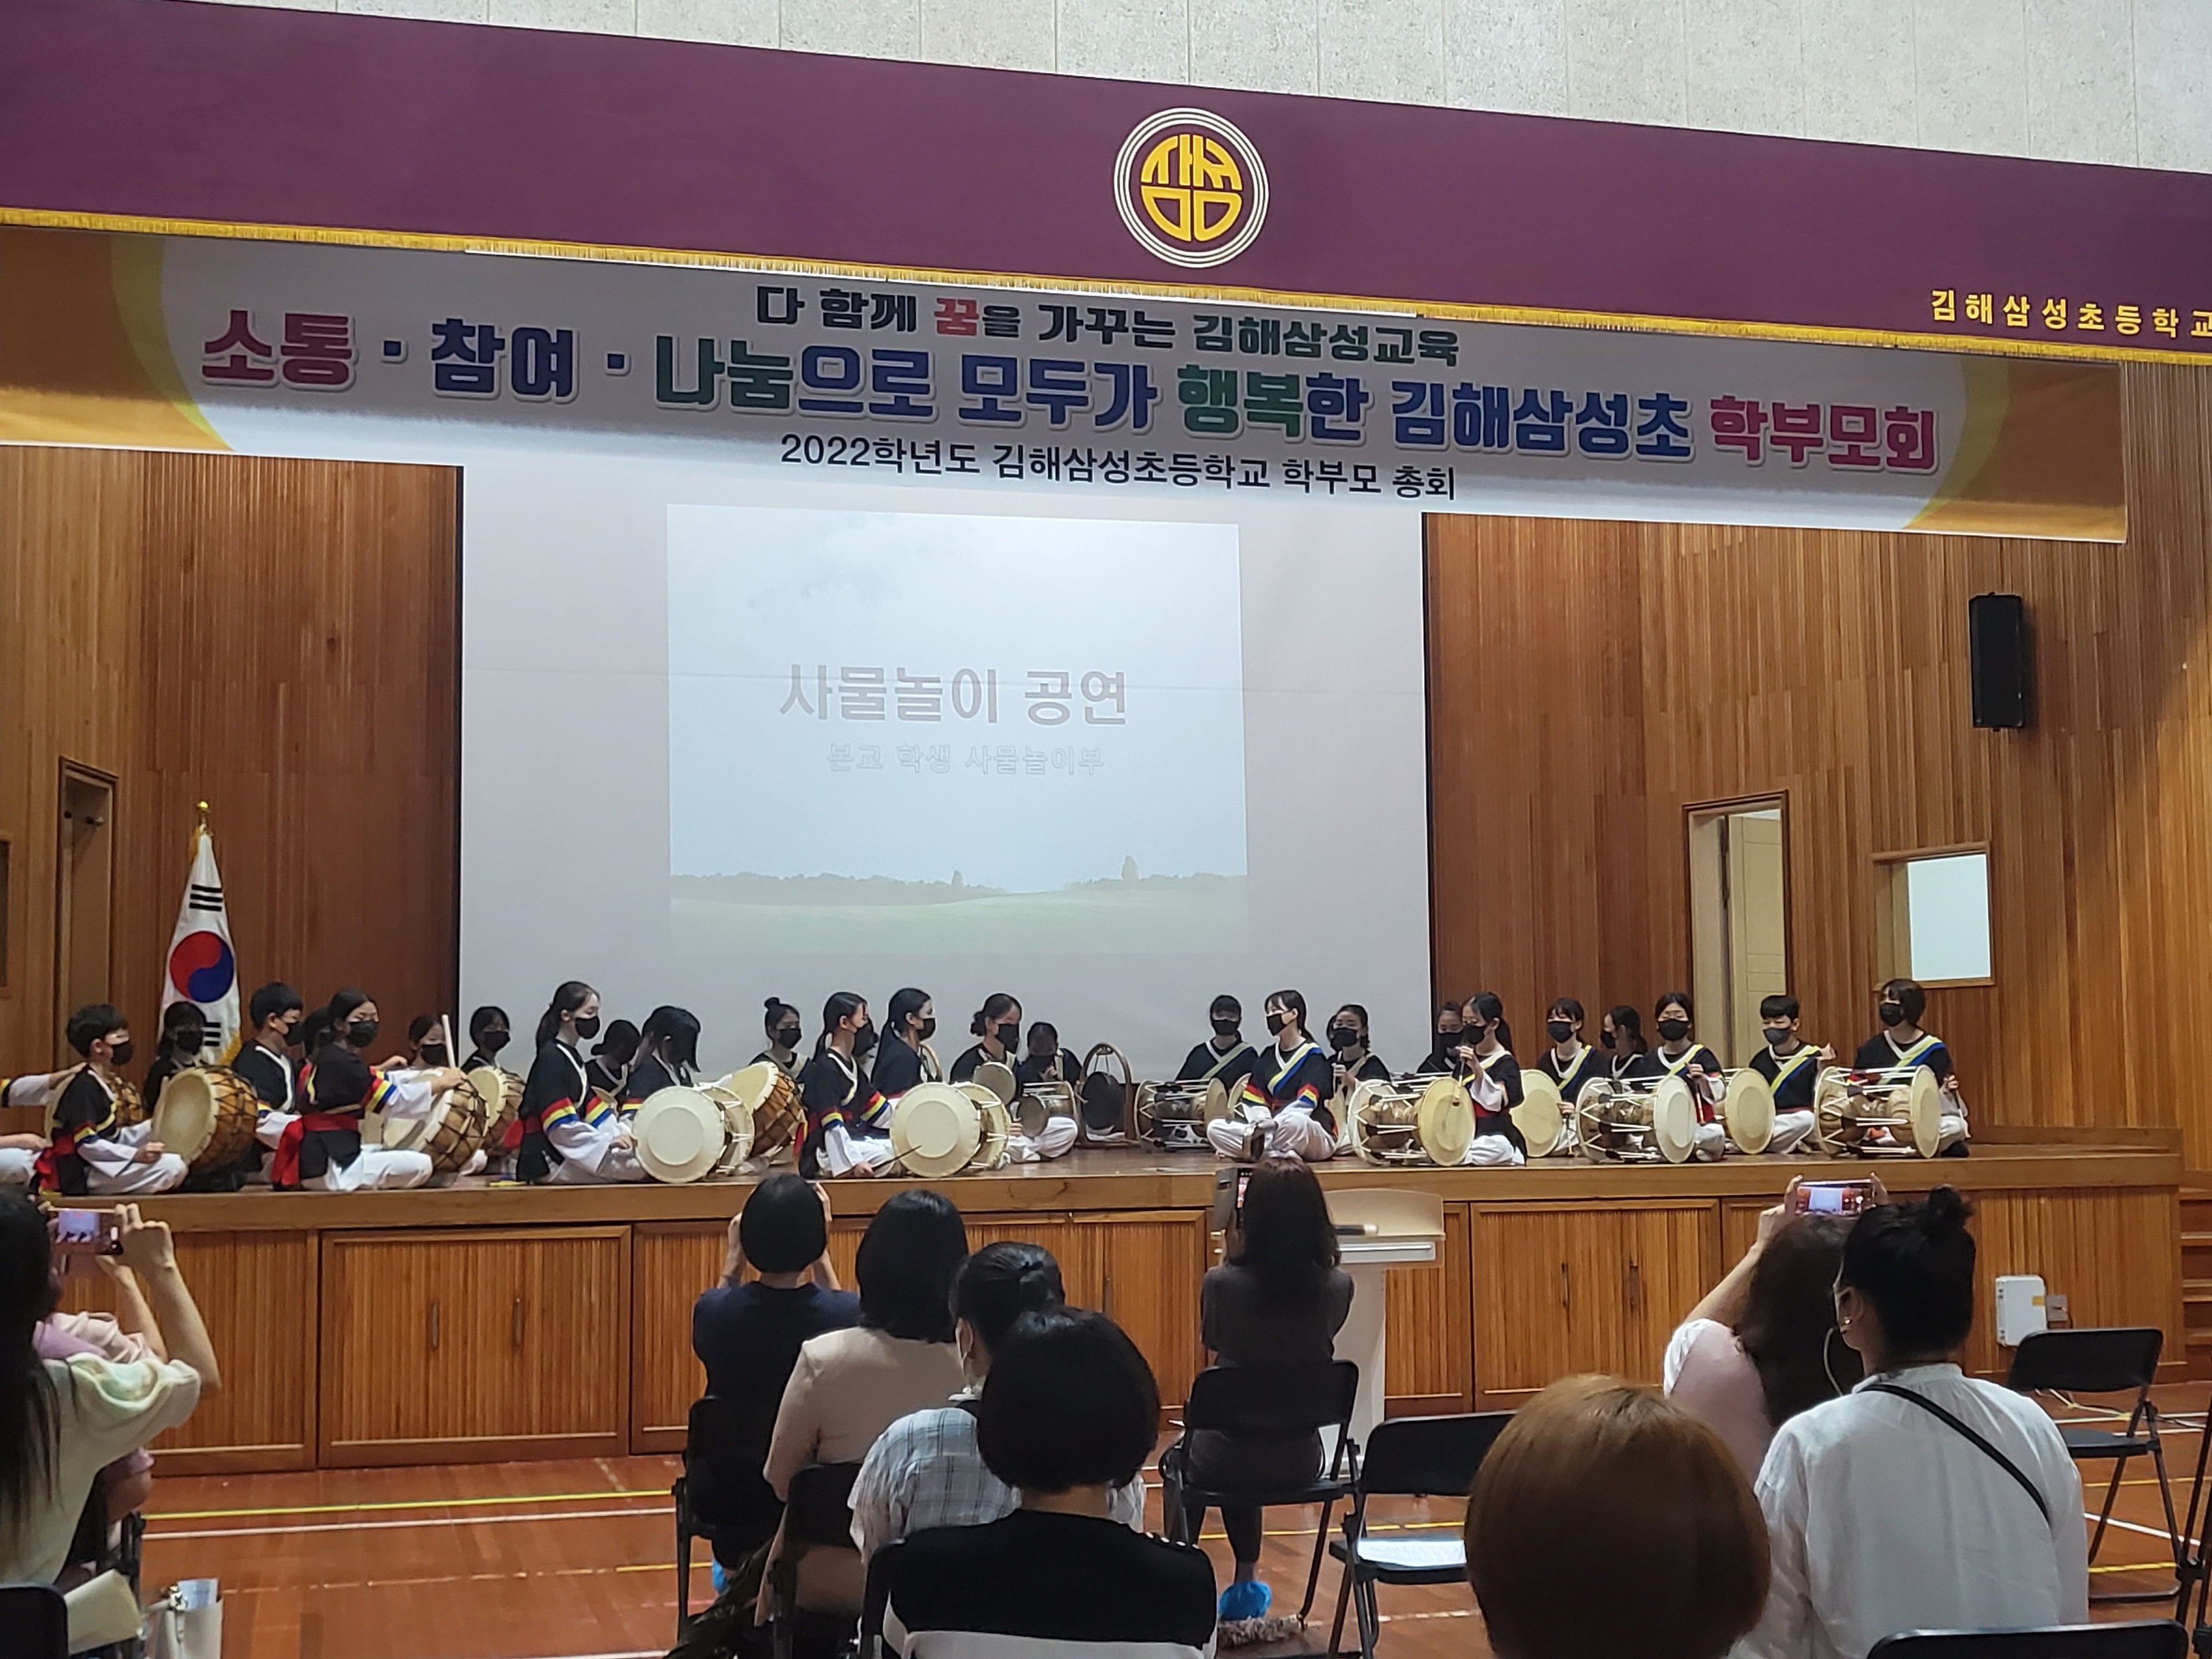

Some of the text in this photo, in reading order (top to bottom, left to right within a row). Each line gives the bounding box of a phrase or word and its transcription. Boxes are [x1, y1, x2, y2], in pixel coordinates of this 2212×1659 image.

[757, 286, 1459, 367] 다 함께 꿈을 가꾸는 김해삼성교육
[1931, 290, 2212, 338] 김해삼성초등학교
[202, 309, 352, 385] 소통
[431, 318, 576, 397] 참여
[657, 335, 934, 417] 나눔으로
[959, 353, 1158, 430] 모두가
[1176, 364, 1368, 439] 행복한
[1391, 381, 1692, 456] 김해삼성초
[1709, 395, 1938, 470] 학부모회
[780, 435, 1457, 500] 2022학년도 김해삼성초등학교 학부모 총회
[780, 664, 1126, 725] 사물놀이 공연
[826, 743, 1105, 776] 본교 학생 사물놀이부
